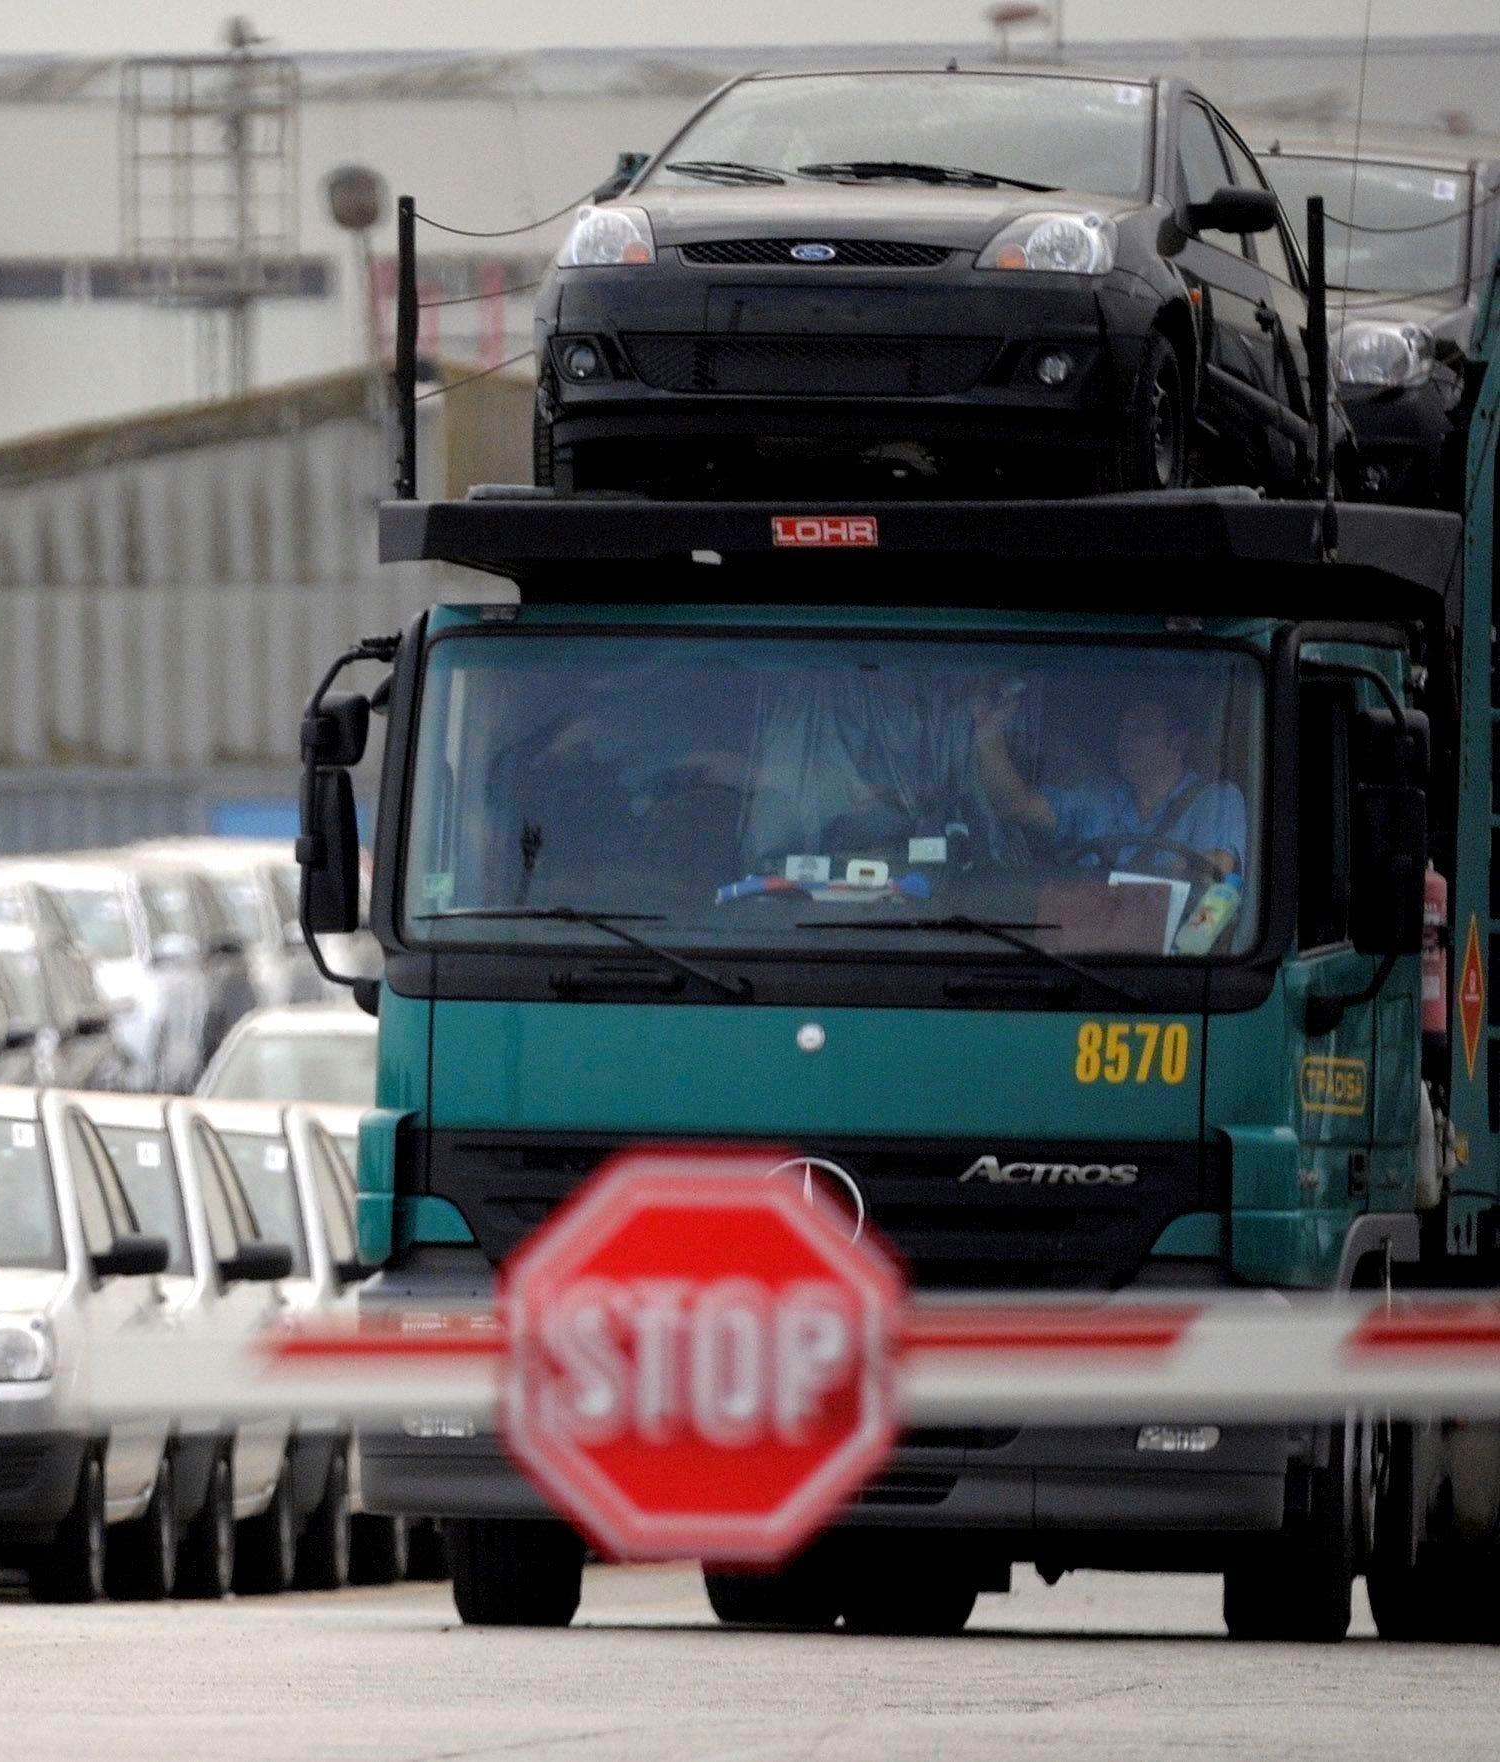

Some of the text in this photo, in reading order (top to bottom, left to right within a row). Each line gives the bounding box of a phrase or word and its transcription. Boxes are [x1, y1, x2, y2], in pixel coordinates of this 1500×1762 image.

[776, 521, 874, 541] LOHR
[1076, 1022, 1188, 1083] 8570
[542, 1277, 850, 1447] STOP
